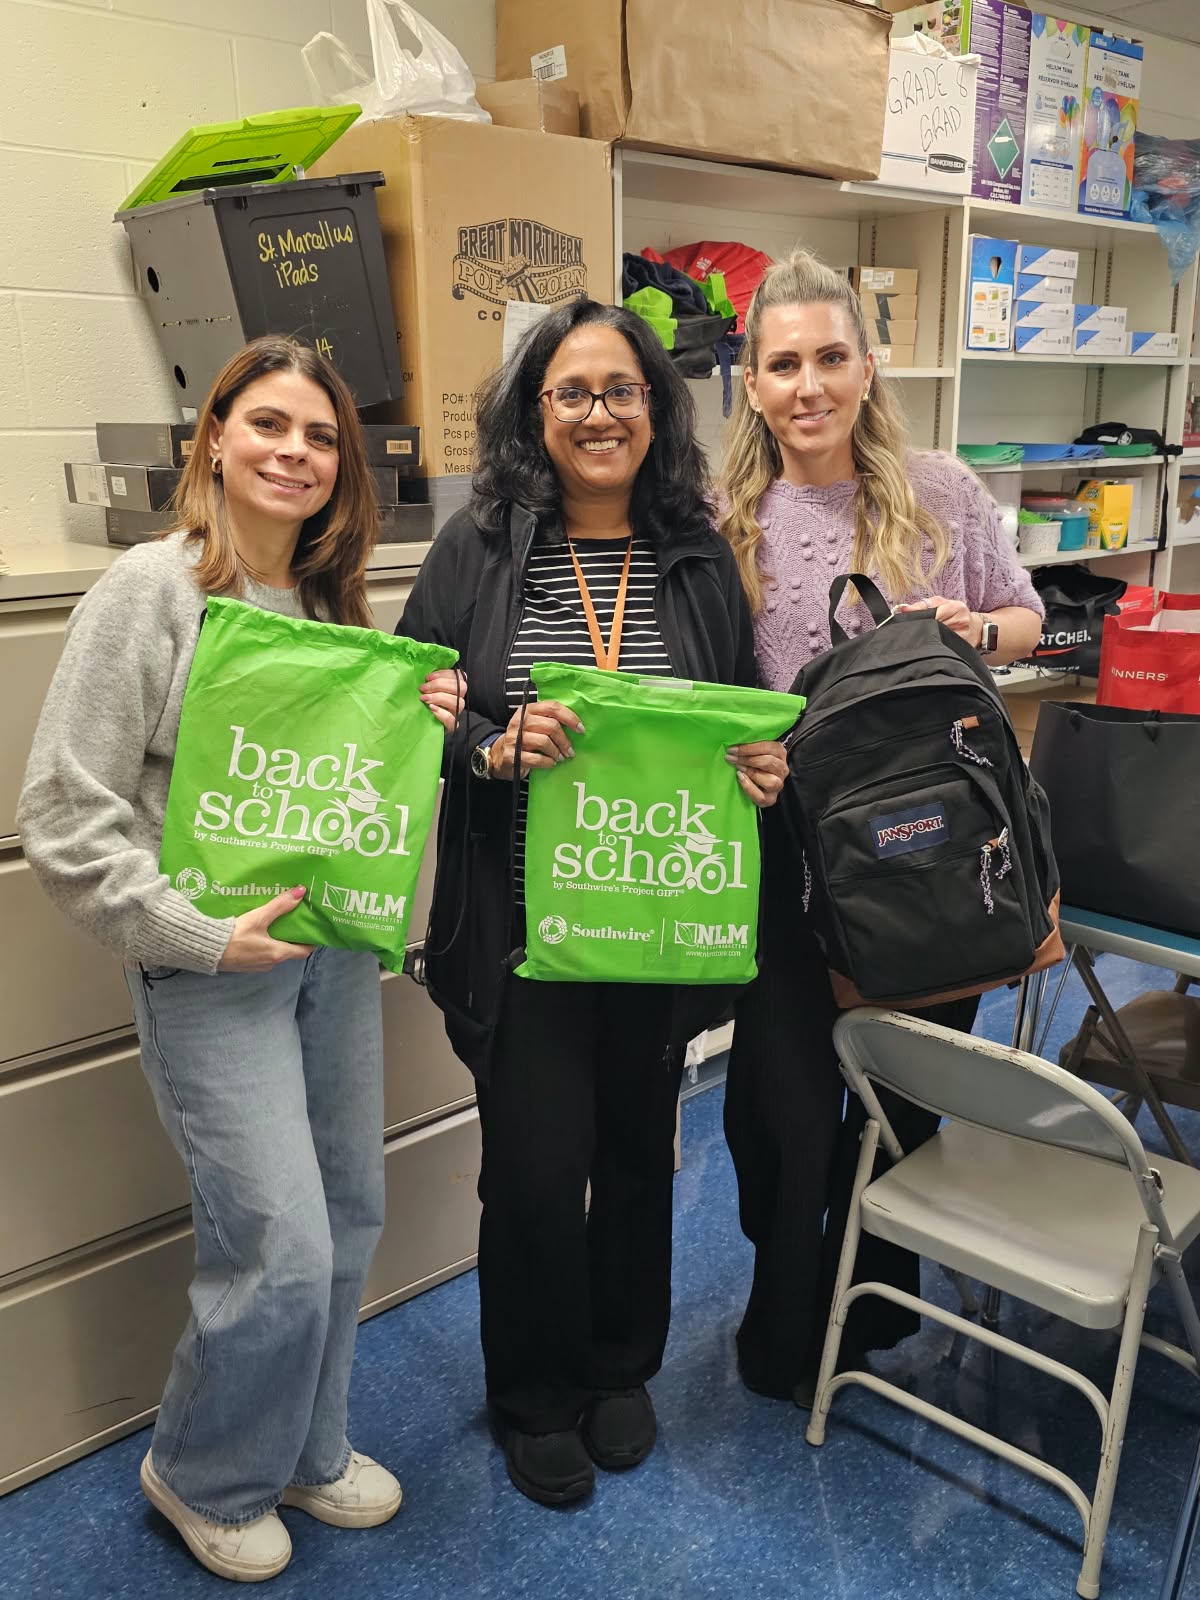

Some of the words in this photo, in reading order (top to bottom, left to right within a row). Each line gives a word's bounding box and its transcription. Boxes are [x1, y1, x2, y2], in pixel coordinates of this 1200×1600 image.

[1118, 70, 1130, 79] TANK
[888, 63, 948, 115] GRADE
[956, 64, 967, 98] 8
[920, 105, 961, 153] GRAD
[953, 161, 965, 169] BOX
[278, 220, 354, 257] Marcellus
[458, 219, 507, 265] GREAT
[509, 218, 583, 267] NORTHERN
[272, 258, 319, 289] iPads
[443, 428, 462, 439] Pcs
[464, 430, 477, 441] pe
[444, 445, 474, 456] Gross
[445, 463, 472, 474] Meas
[1111, 666, 1166, 682] INNERS
[228, 725, 384, 796] back
[252, 781, 273, 800] to
[573, 781, 716, 838] back
[194, 789, 411, 857] school
[194, 830, 207, 841] by
[209, 832, 268, 849] Southwire's
[270, 841, 305, 854] Project
[598, 831, 618, 846] to
[552, 836, 748, 895] school
[210, 880, 291, 897] Southwir
[553, 881, 564, 891] by
[566, 881, 620, 893] Southwire's
[622, 885, 655, 897] Project
[346, 889, 407, 919] NLM
[697, 923, 749, 946] NLM
